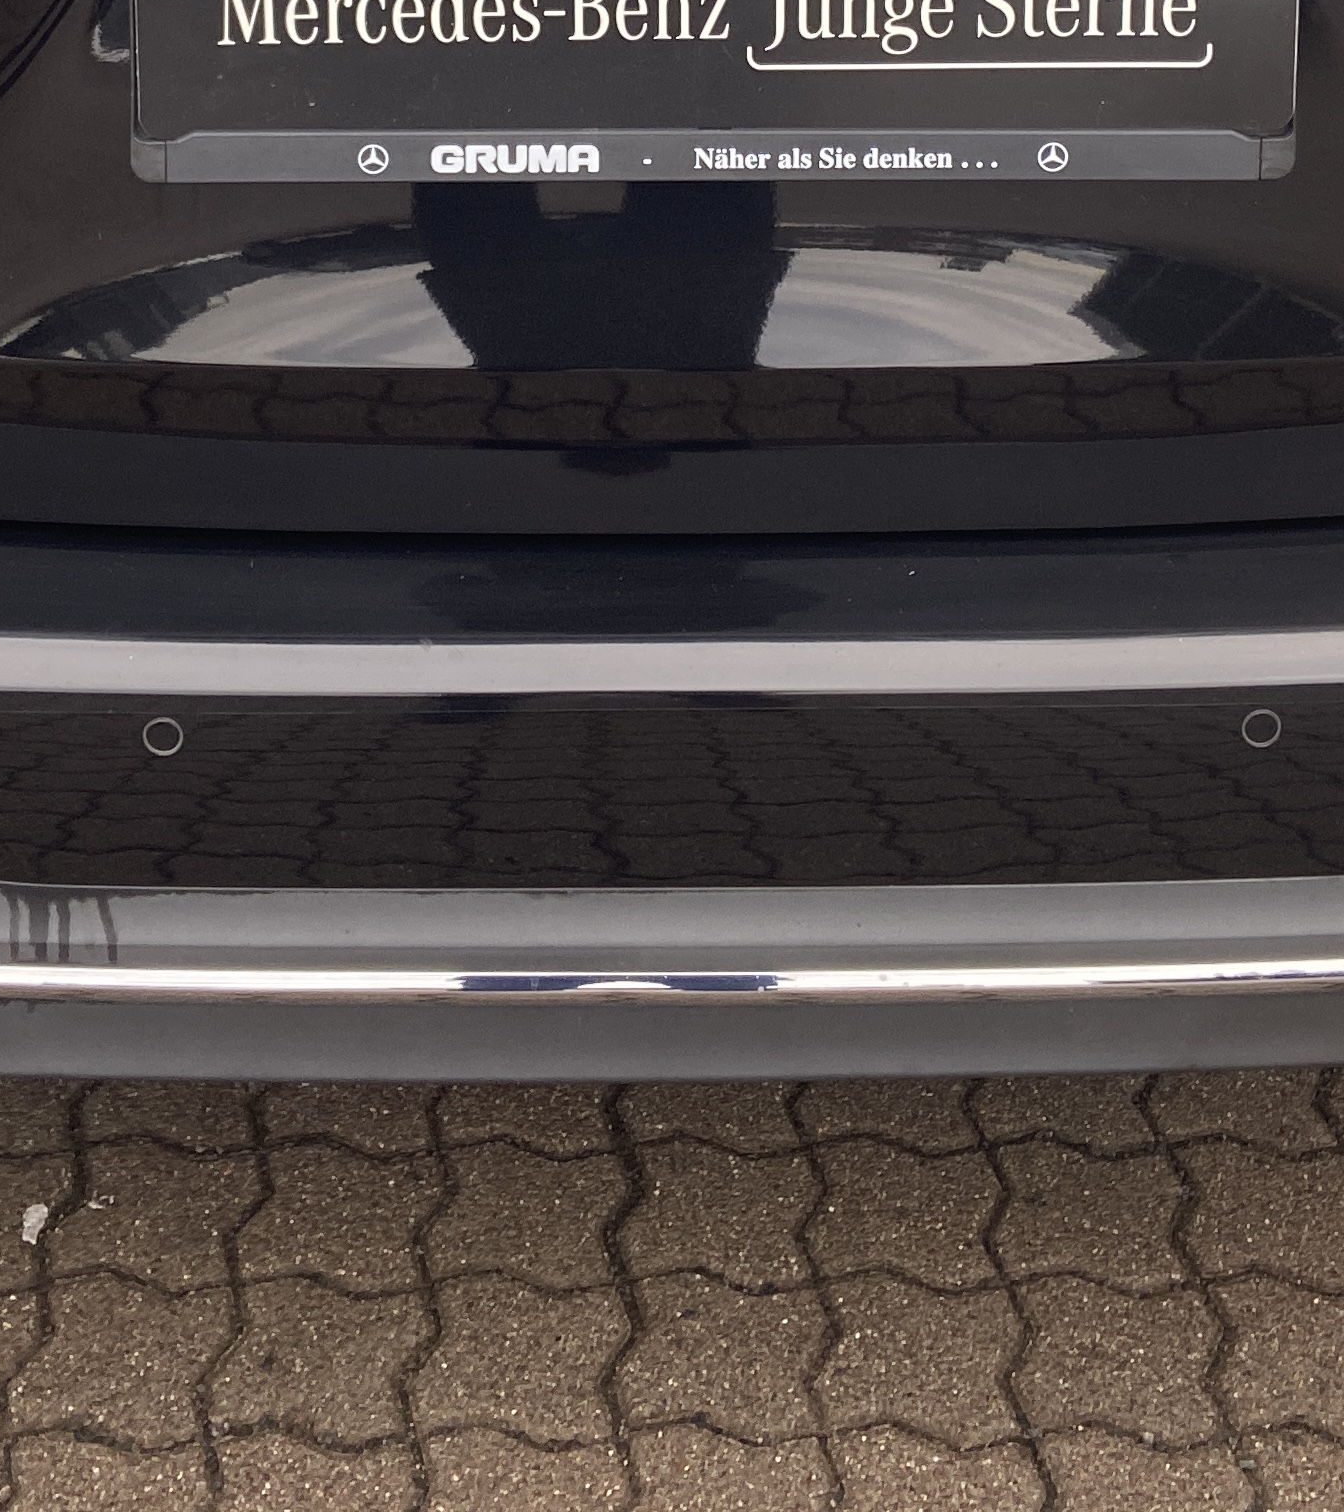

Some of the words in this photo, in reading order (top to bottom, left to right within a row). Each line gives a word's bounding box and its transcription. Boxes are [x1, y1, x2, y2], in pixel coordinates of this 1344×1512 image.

[430, 144, 601, 174] GRUMA
[693, 146, 772, 170] Näher
[777, 146, 813, 170] als
[818, 146, 857, 170] Sie
[862, 146, 953, 170] denken
